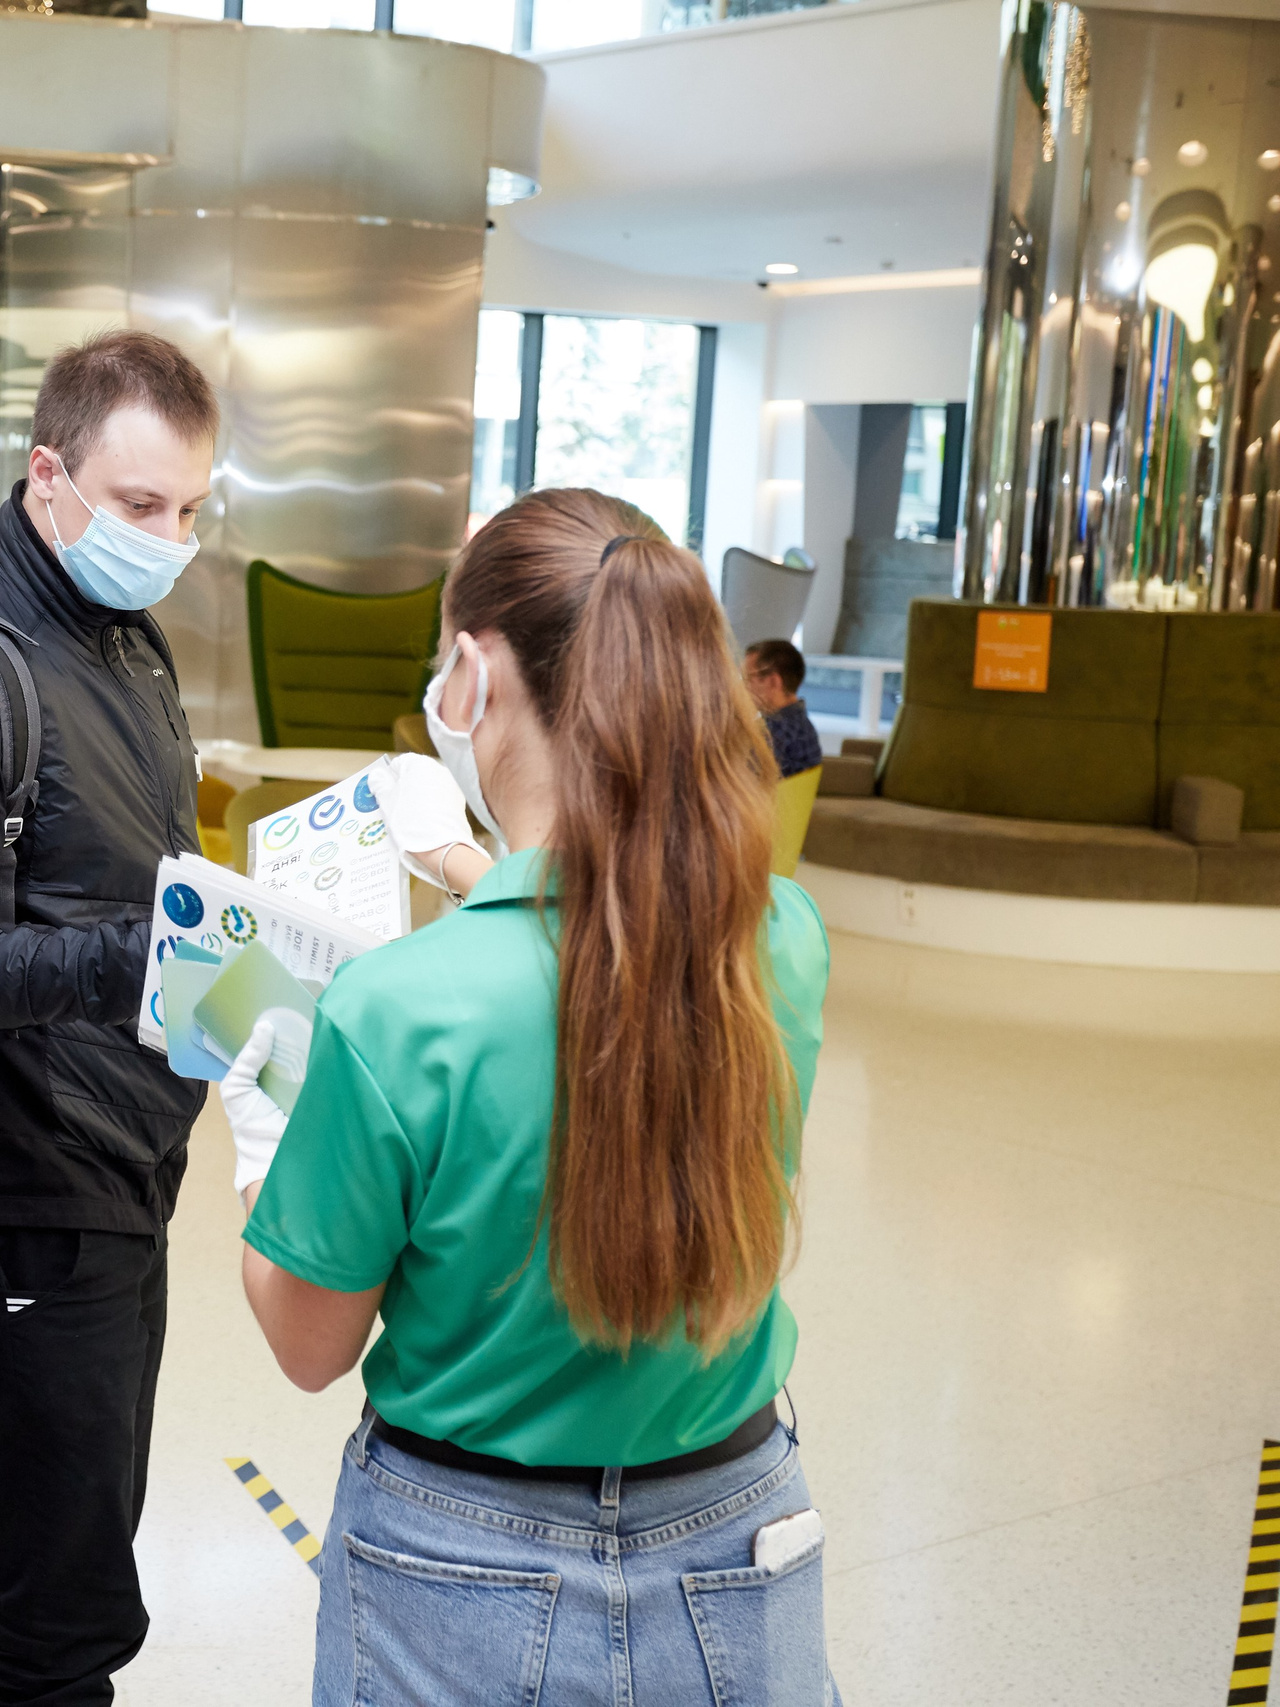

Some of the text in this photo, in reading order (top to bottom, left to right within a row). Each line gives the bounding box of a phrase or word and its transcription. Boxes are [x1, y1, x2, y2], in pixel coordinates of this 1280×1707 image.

[271, 854, 301, 873] ДНЯ!
[371, 890, 392, 901] STOP
[326, 942, 335, 965] STOP
